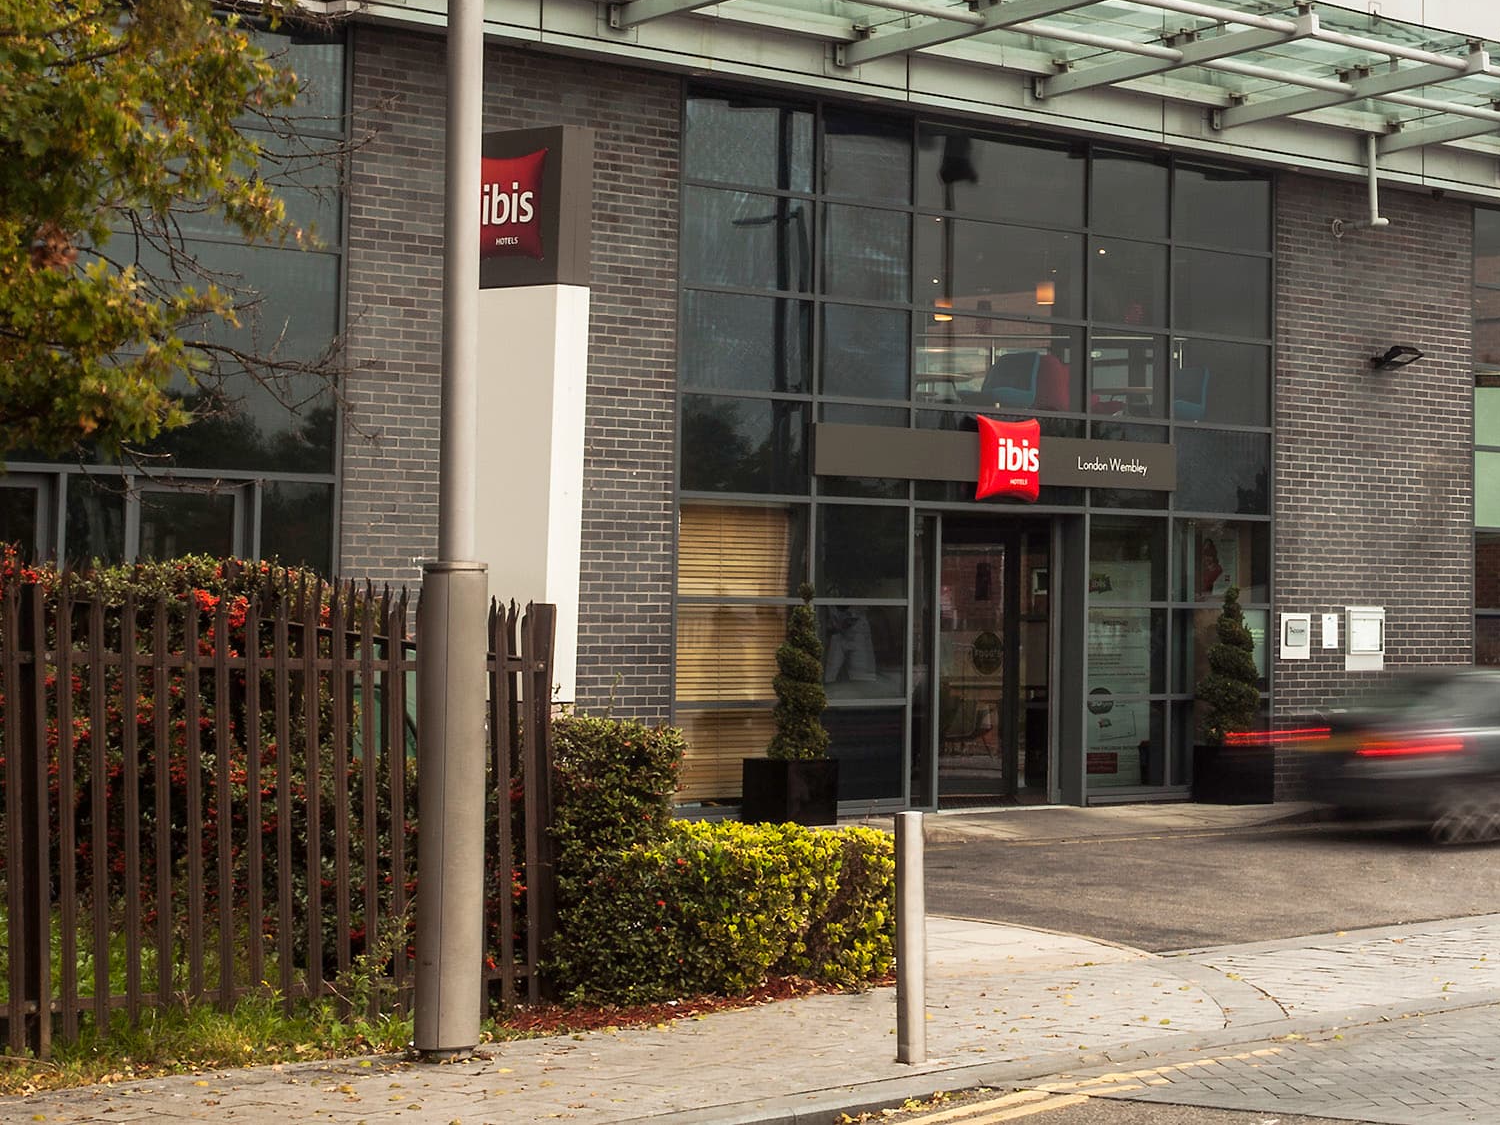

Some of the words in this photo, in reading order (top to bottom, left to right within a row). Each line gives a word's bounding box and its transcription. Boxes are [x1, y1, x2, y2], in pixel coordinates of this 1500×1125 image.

[482, 181, 534, 225] ibis
[495, 236, 519, 246] HOTELS
[998, 437, 1040, 472] ibis
[1078, 456, 1108, 471] London
[1109, 457, 1148, 477] Wembley
